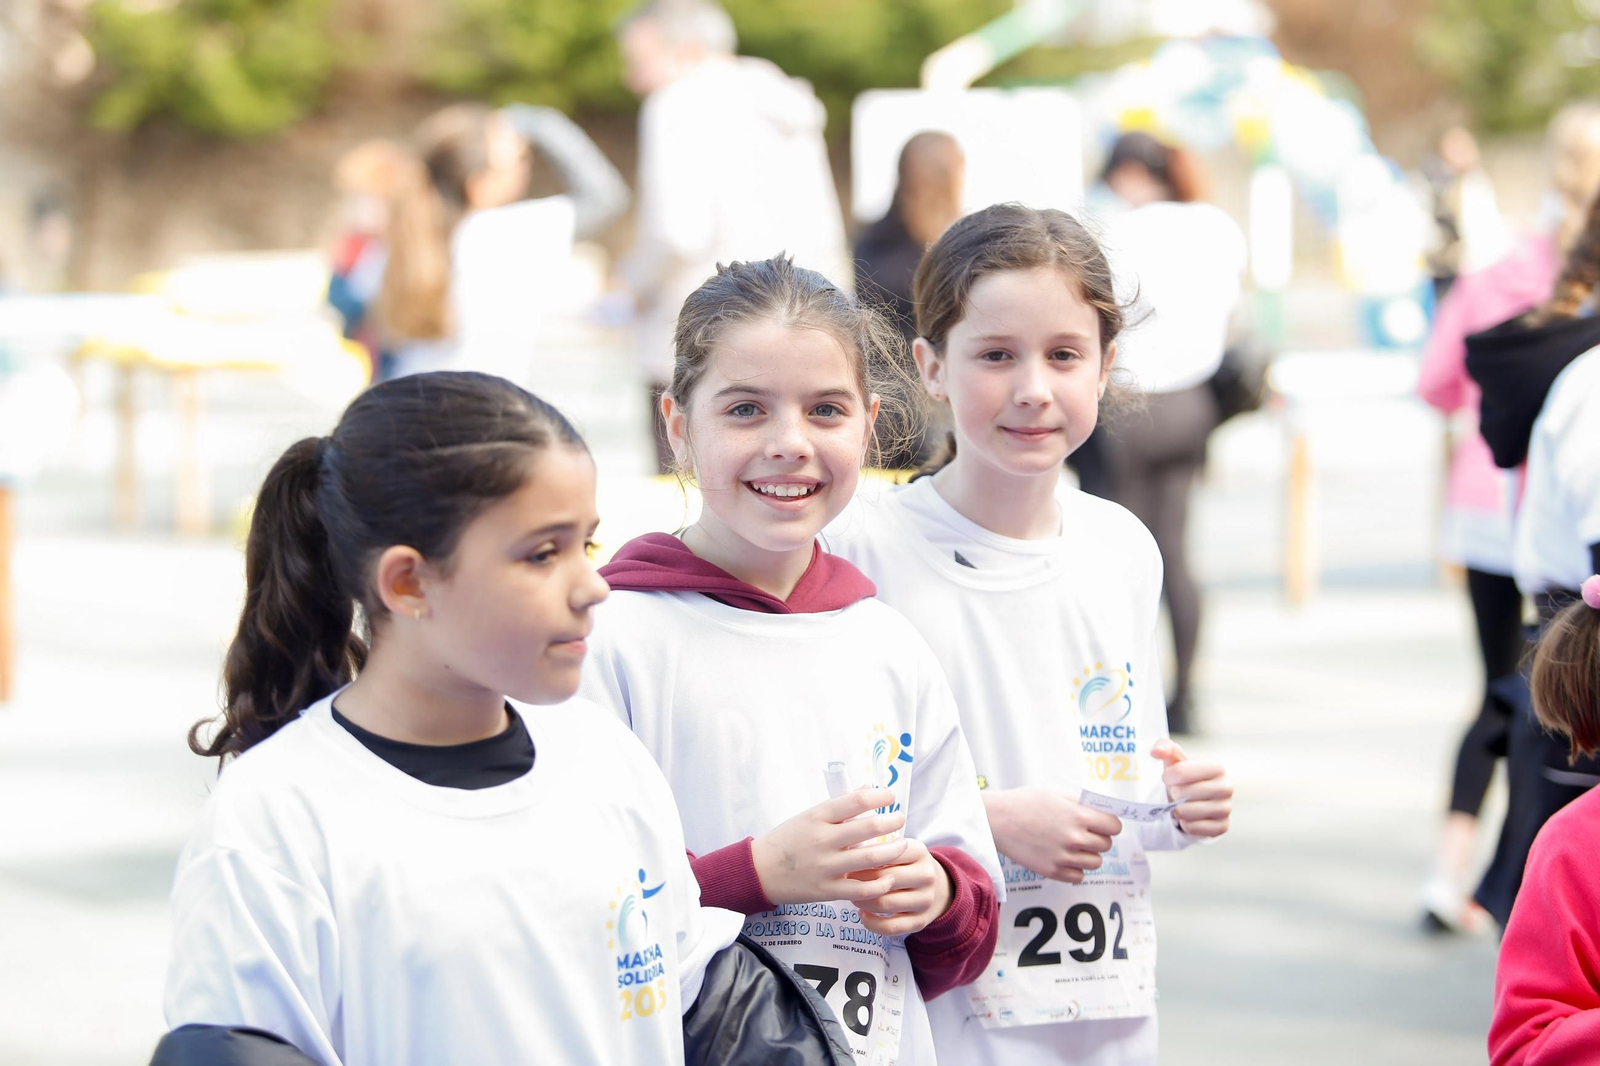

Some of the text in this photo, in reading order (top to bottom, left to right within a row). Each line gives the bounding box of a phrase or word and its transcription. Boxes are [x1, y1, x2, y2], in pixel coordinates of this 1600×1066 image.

[1079, 725, 1136, 739] MARCH
[773, 902, 837, 919] MARCHA
[840, 907, 864, 924] SO
[816, 922, 835, 938] LA
[1014, 901, 1129, 967] 292
[851, 946, 867, 955] PLAZA
[793, 963, 877, 1037] 78
